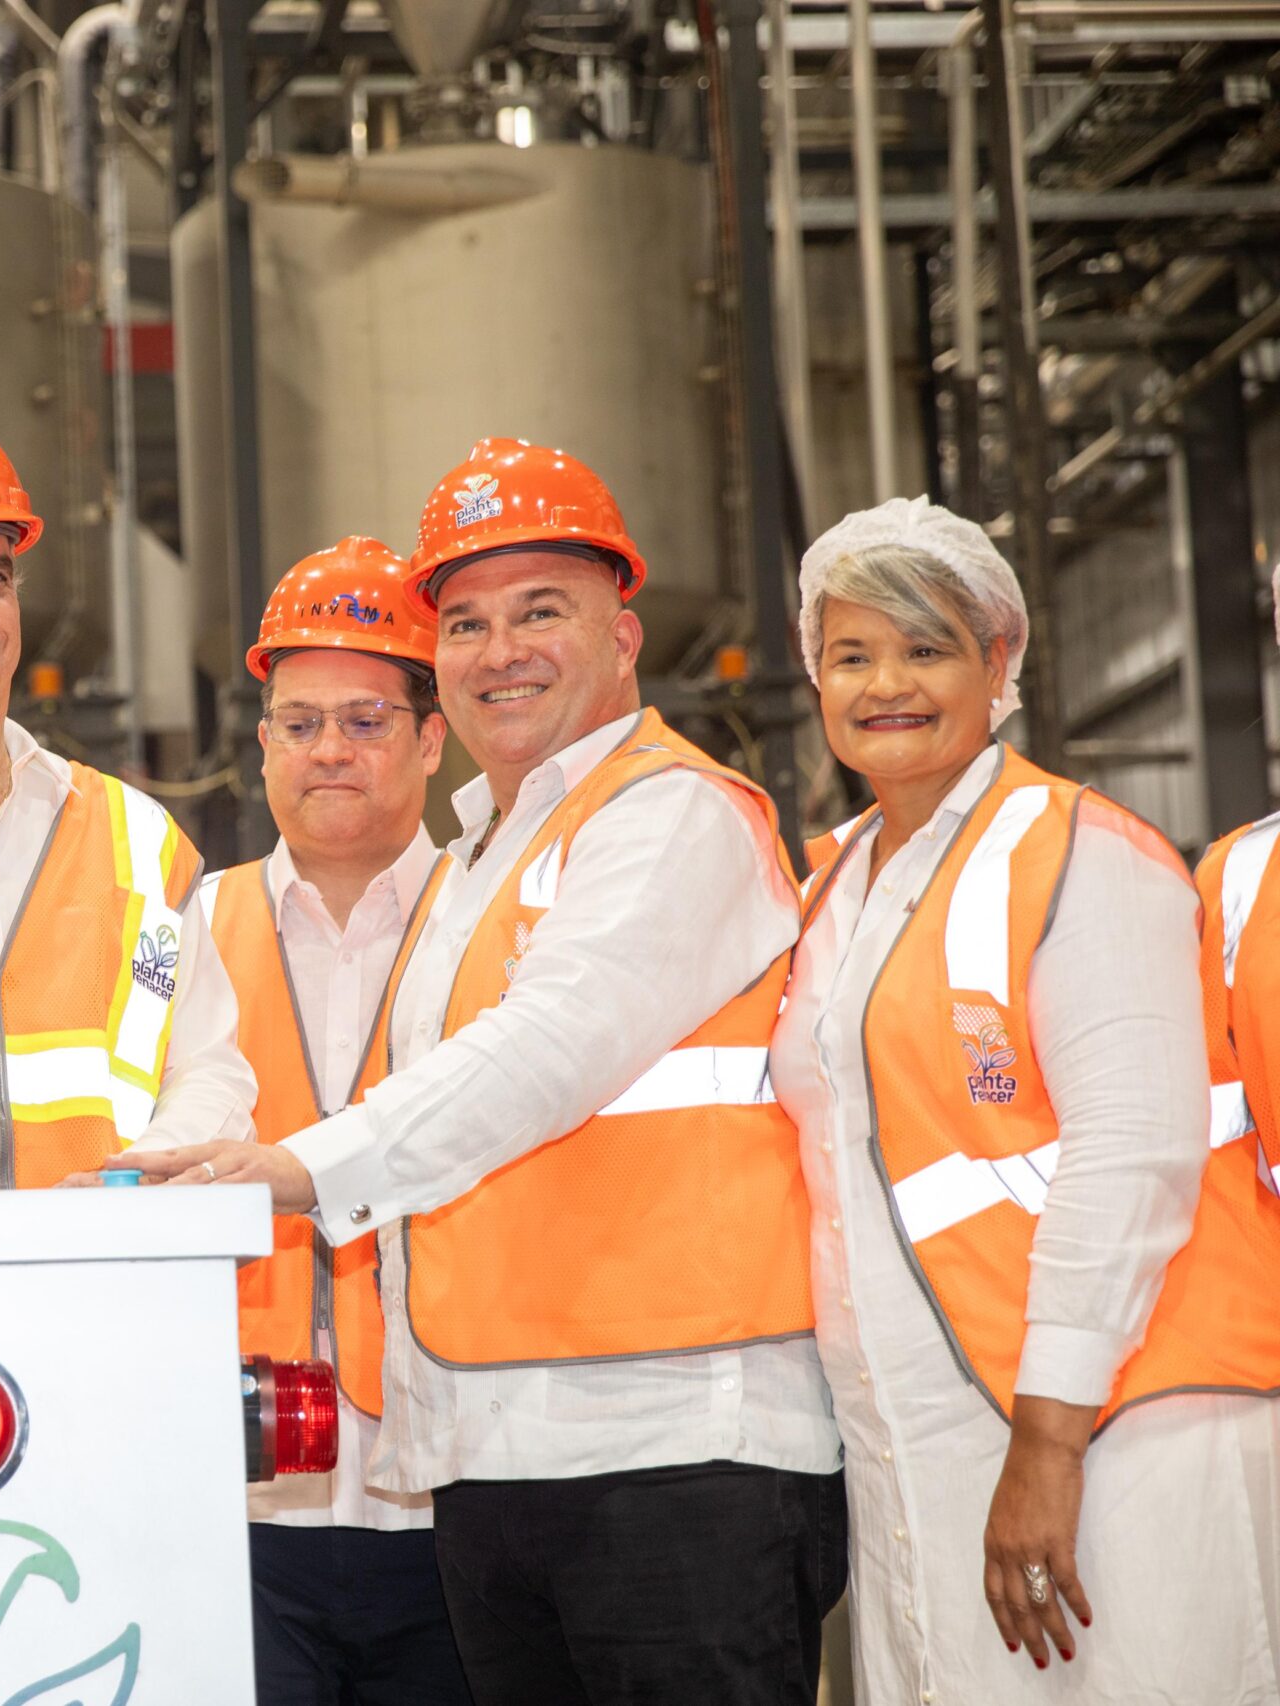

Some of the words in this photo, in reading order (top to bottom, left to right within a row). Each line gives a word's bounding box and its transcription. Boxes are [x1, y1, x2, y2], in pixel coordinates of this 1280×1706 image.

[132, 959, 176, 993] planta
[132, 972, 173, 1003] renacer
[968, 1073, 1016, 1091] panta
